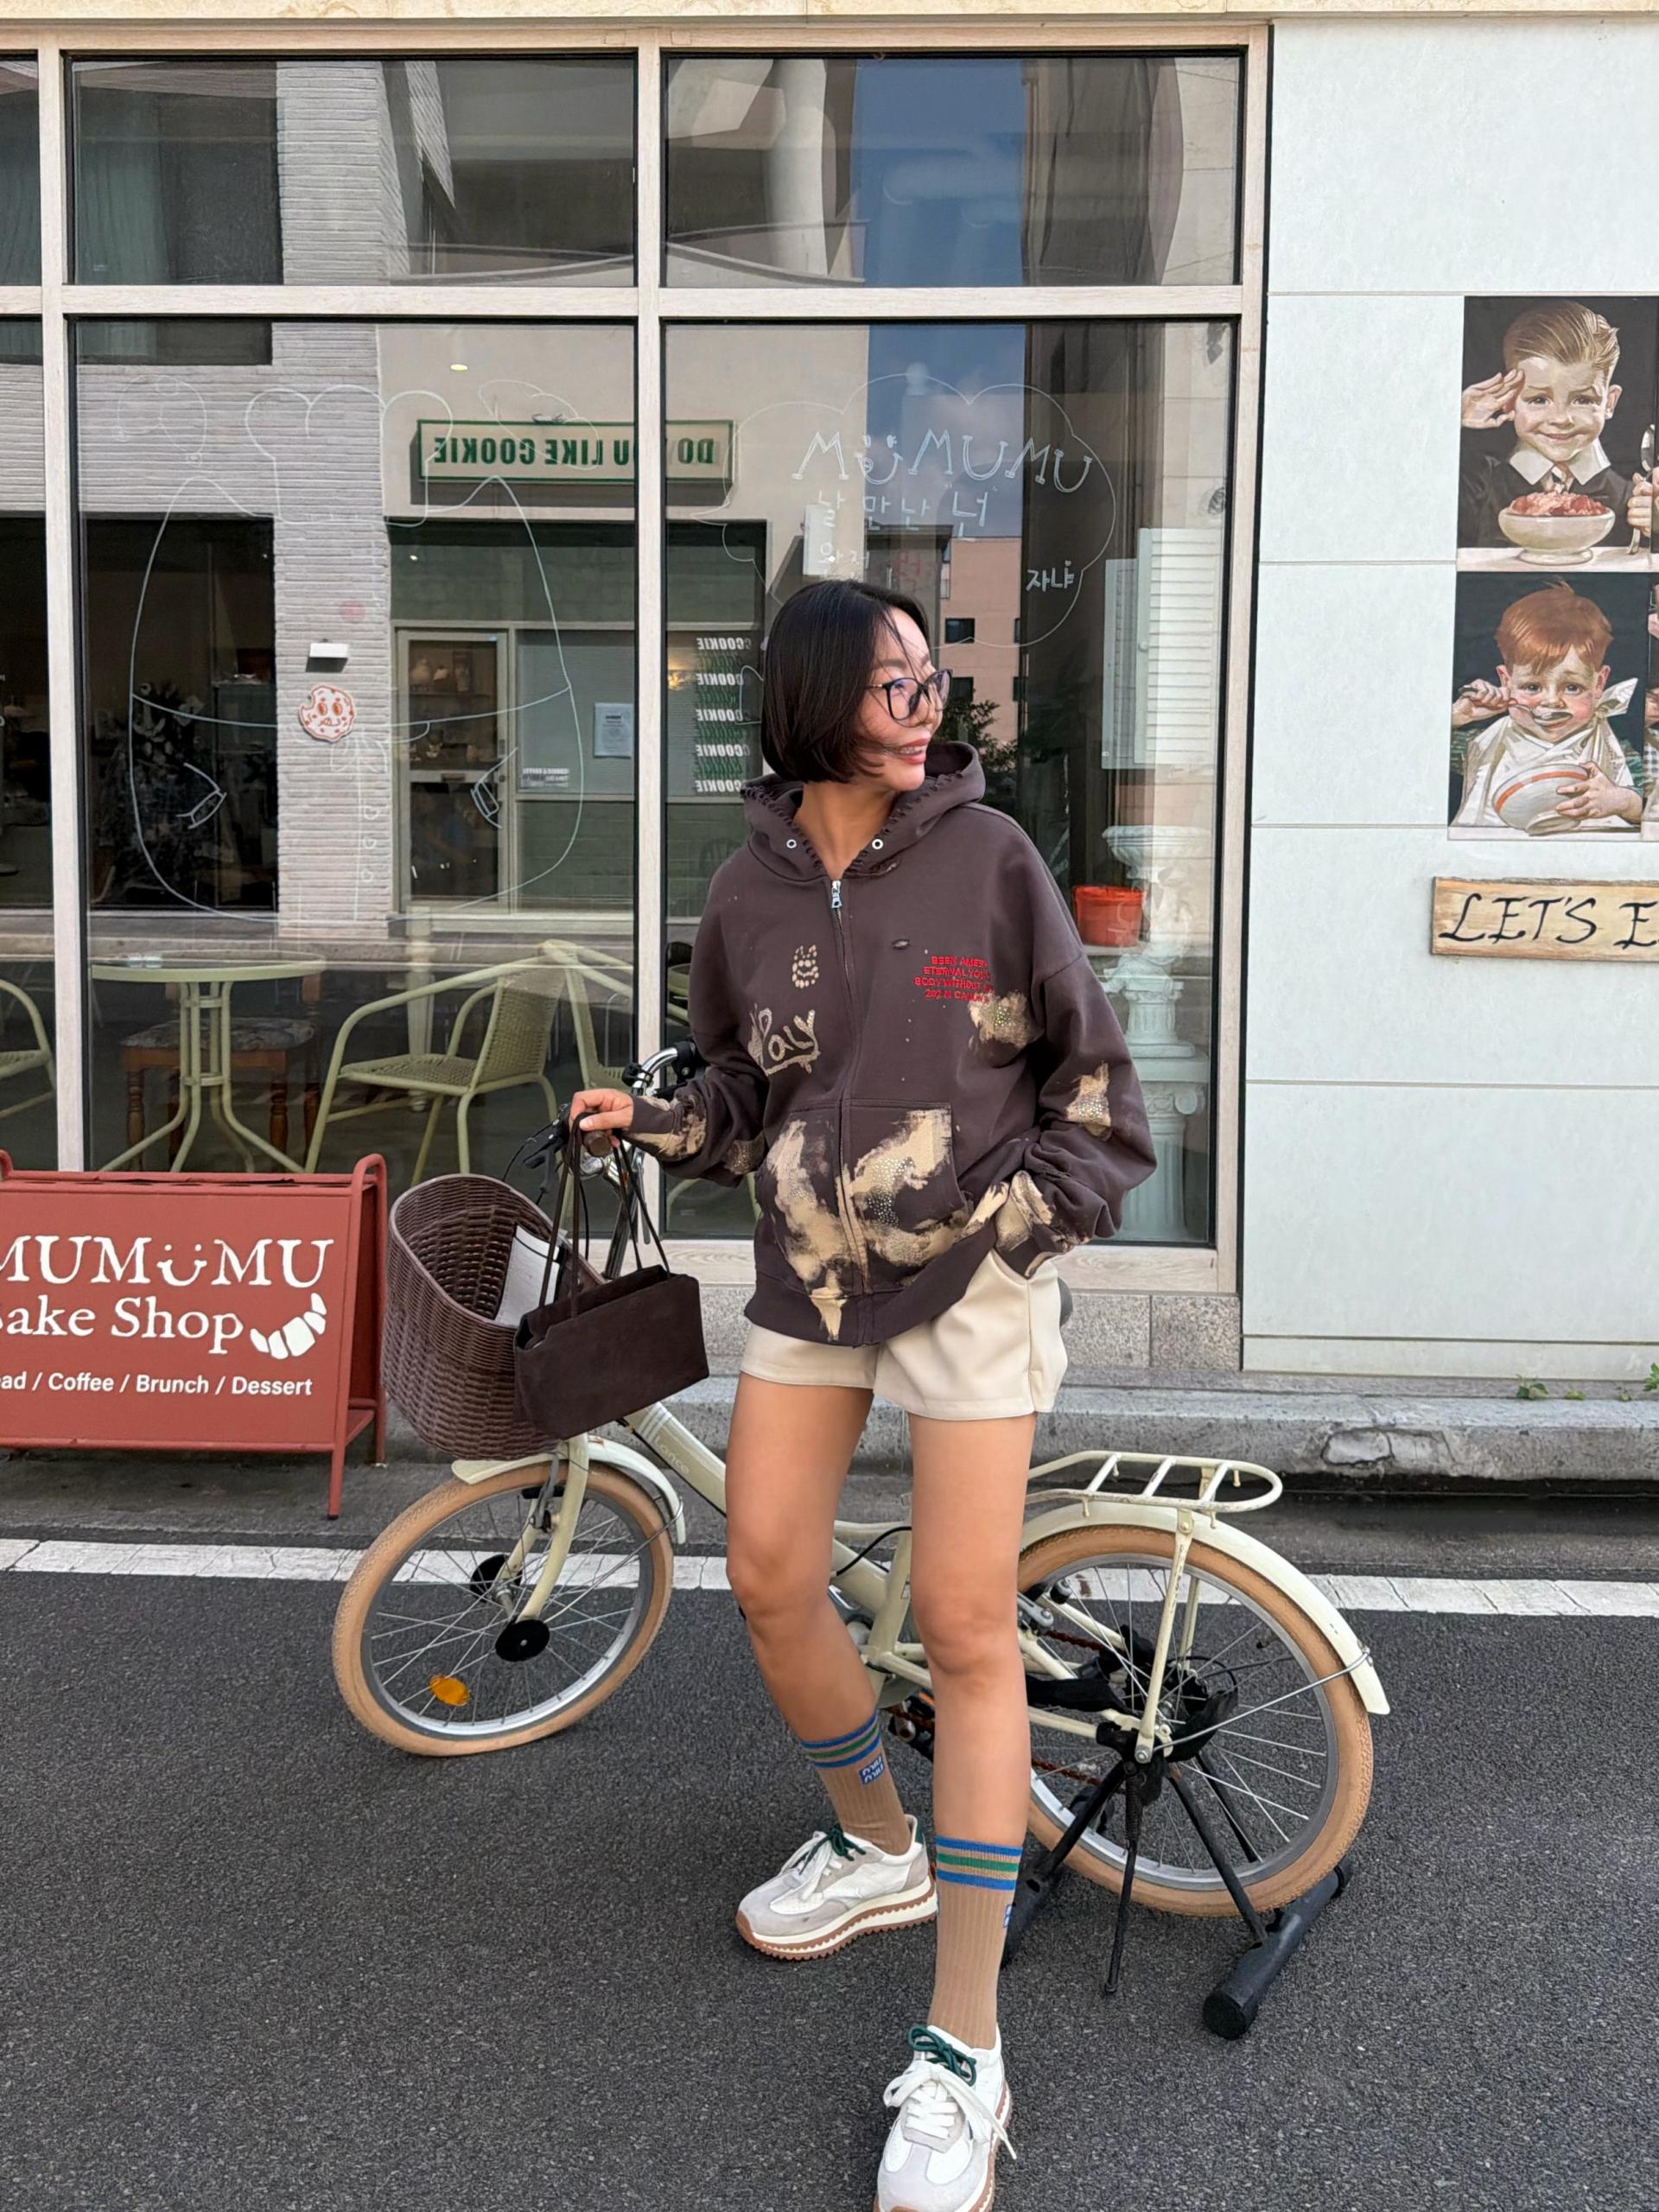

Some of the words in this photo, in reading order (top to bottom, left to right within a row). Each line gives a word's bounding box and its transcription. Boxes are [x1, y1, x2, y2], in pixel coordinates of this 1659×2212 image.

[1438, 893, 1597, 944] LET'S
[1613, 900, 1659, 950] E
[0, 1294, 96, 1338] ake
[111, 1294, 244, 1355] Shop
[0, 1370, 27, 1390] ad
[48, 1372, 114, 1391] Coffee
[136, 1373, 210, 1395] Brunch
[231, 1376, 313, 1396] Dessert
